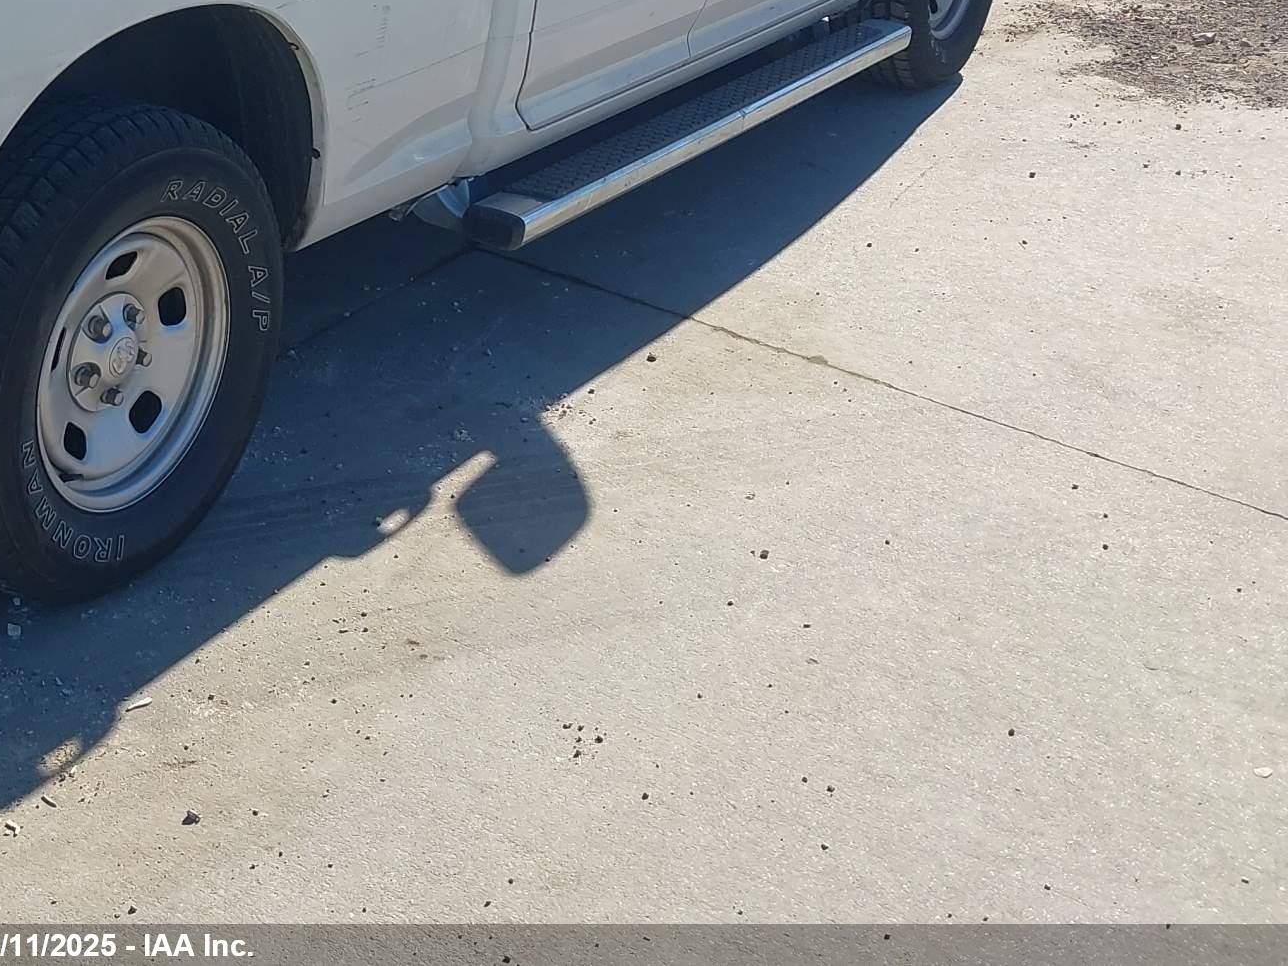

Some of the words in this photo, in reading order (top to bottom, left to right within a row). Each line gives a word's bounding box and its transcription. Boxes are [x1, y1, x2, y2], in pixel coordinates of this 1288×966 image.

[161, 178, 259, 255] RADIAL
[247, 265, 271, 332] A/P
[22, 440, 126, 563] IRONMAN
